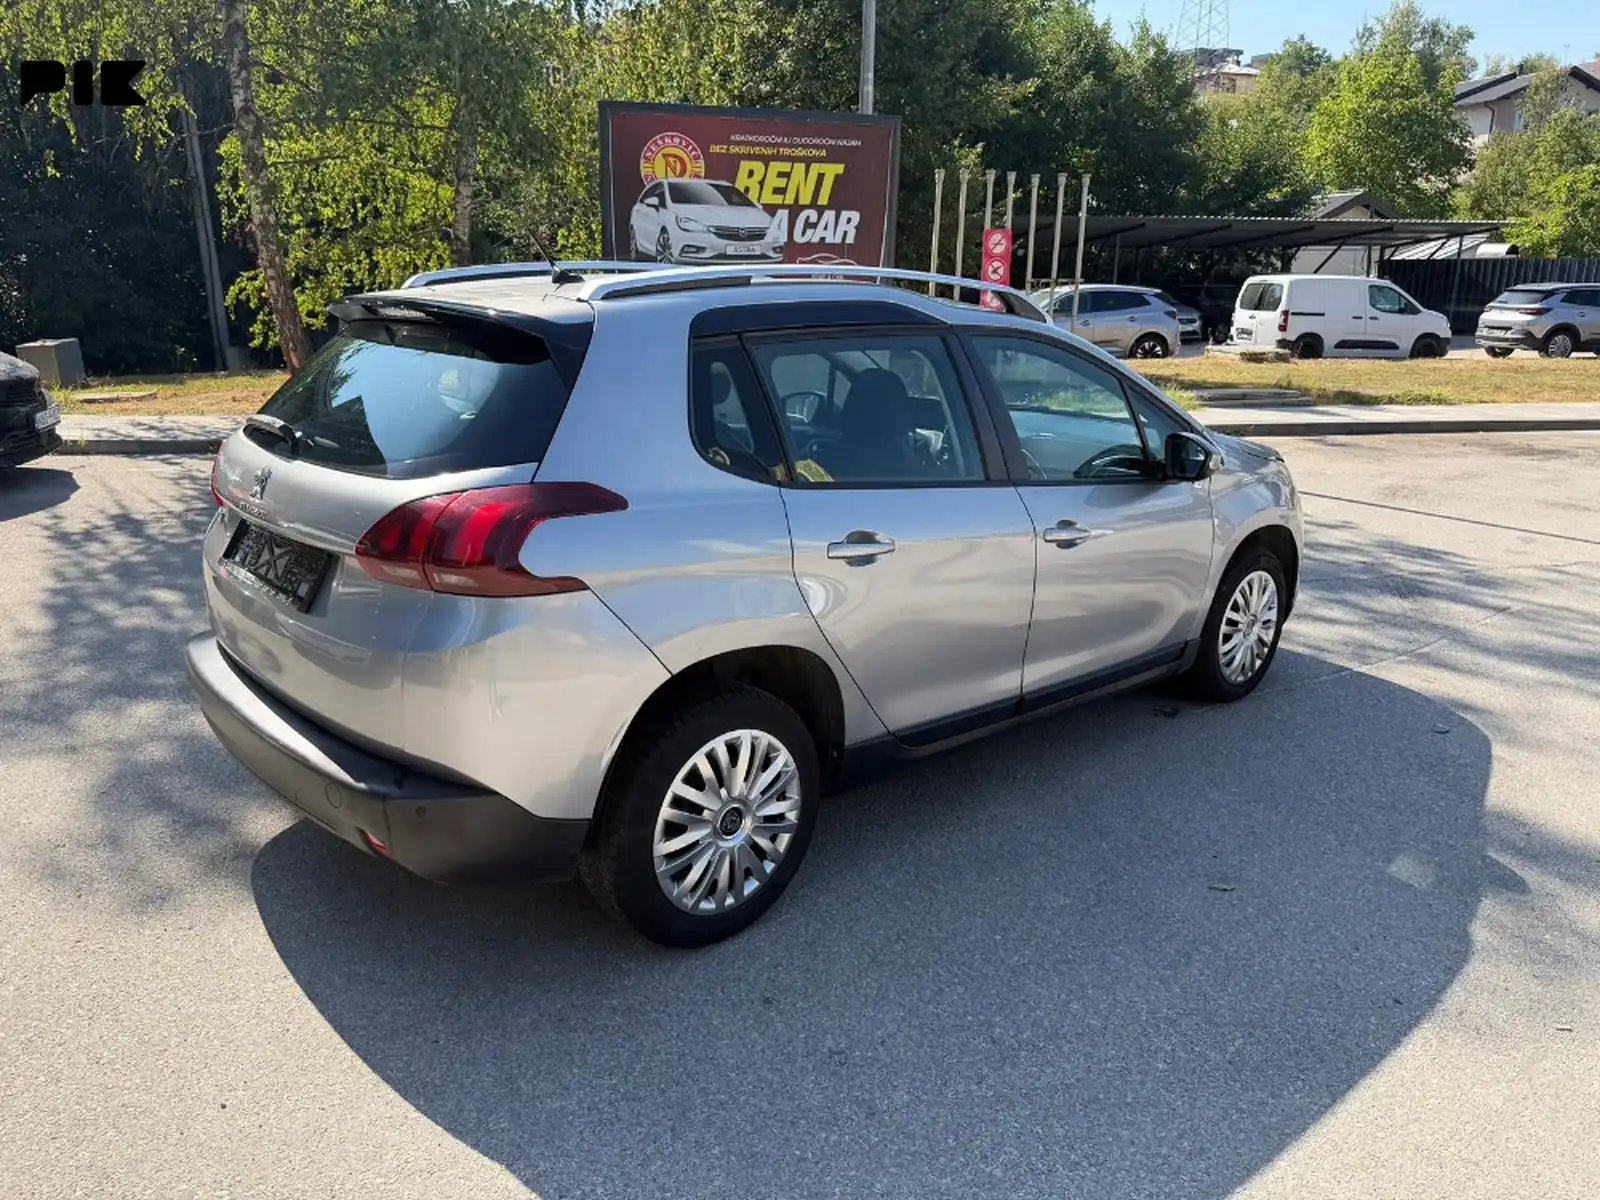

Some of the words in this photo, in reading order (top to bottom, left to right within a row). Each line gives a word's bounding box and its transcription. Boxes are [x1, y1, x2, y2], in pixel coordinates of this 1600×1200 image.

[709, 144, 728, 153] BEZ
[734, 160, 846, 206] RENT
[765, 209, 789, 242] A
[793, 209, 861, 244] CAR
